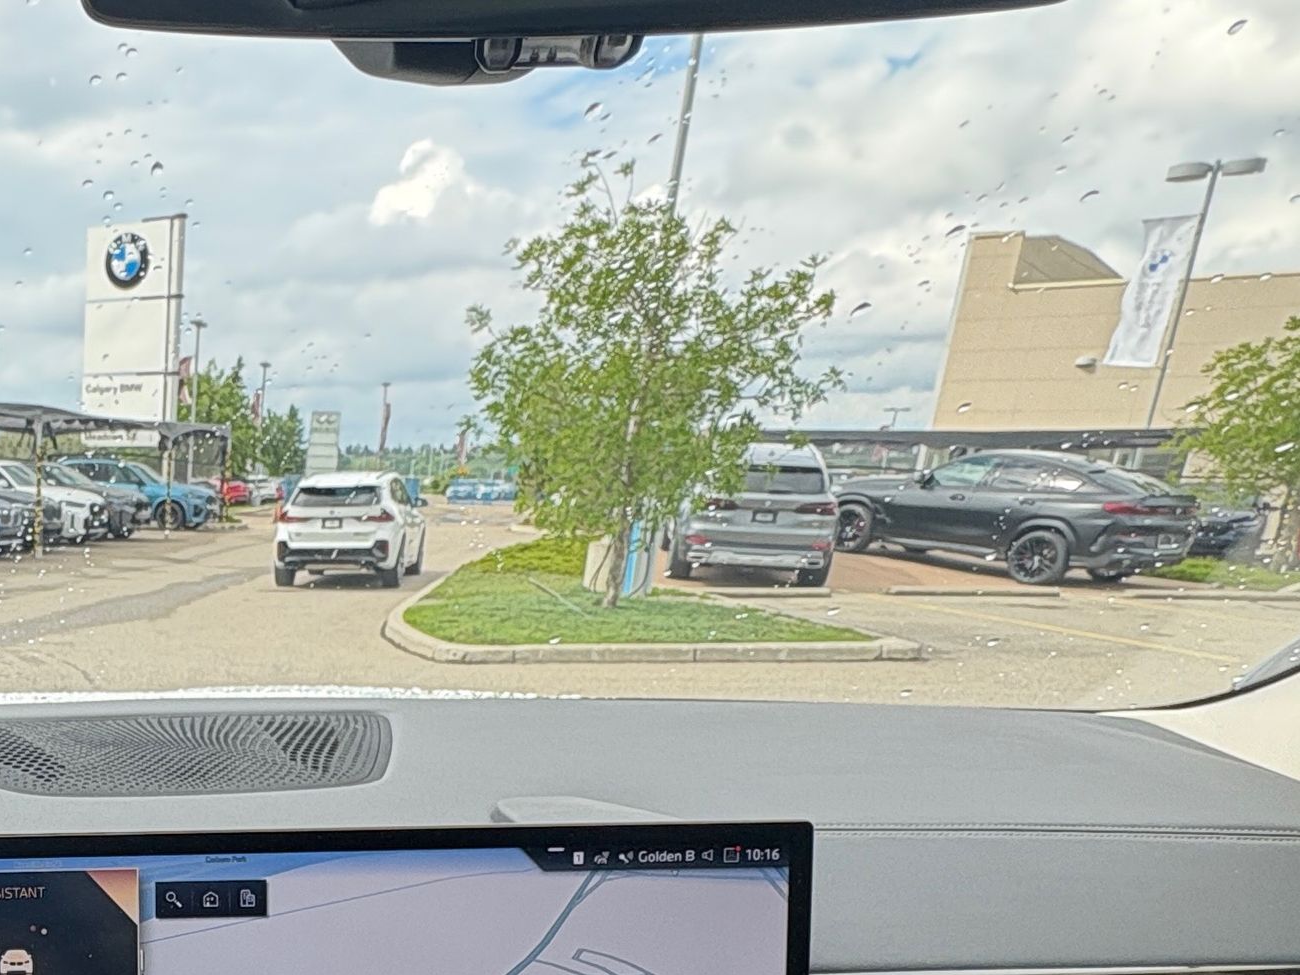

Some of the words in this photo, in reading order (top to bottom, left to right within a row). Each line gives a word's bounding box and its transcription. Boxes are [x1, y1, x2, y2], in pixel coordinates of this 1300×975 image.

[119, 383, 143, 392] BMW
[638, 851, 682, 863] Golden
[685, 850, 695, 862] B
[746, 848, 780, 861] 10:16
